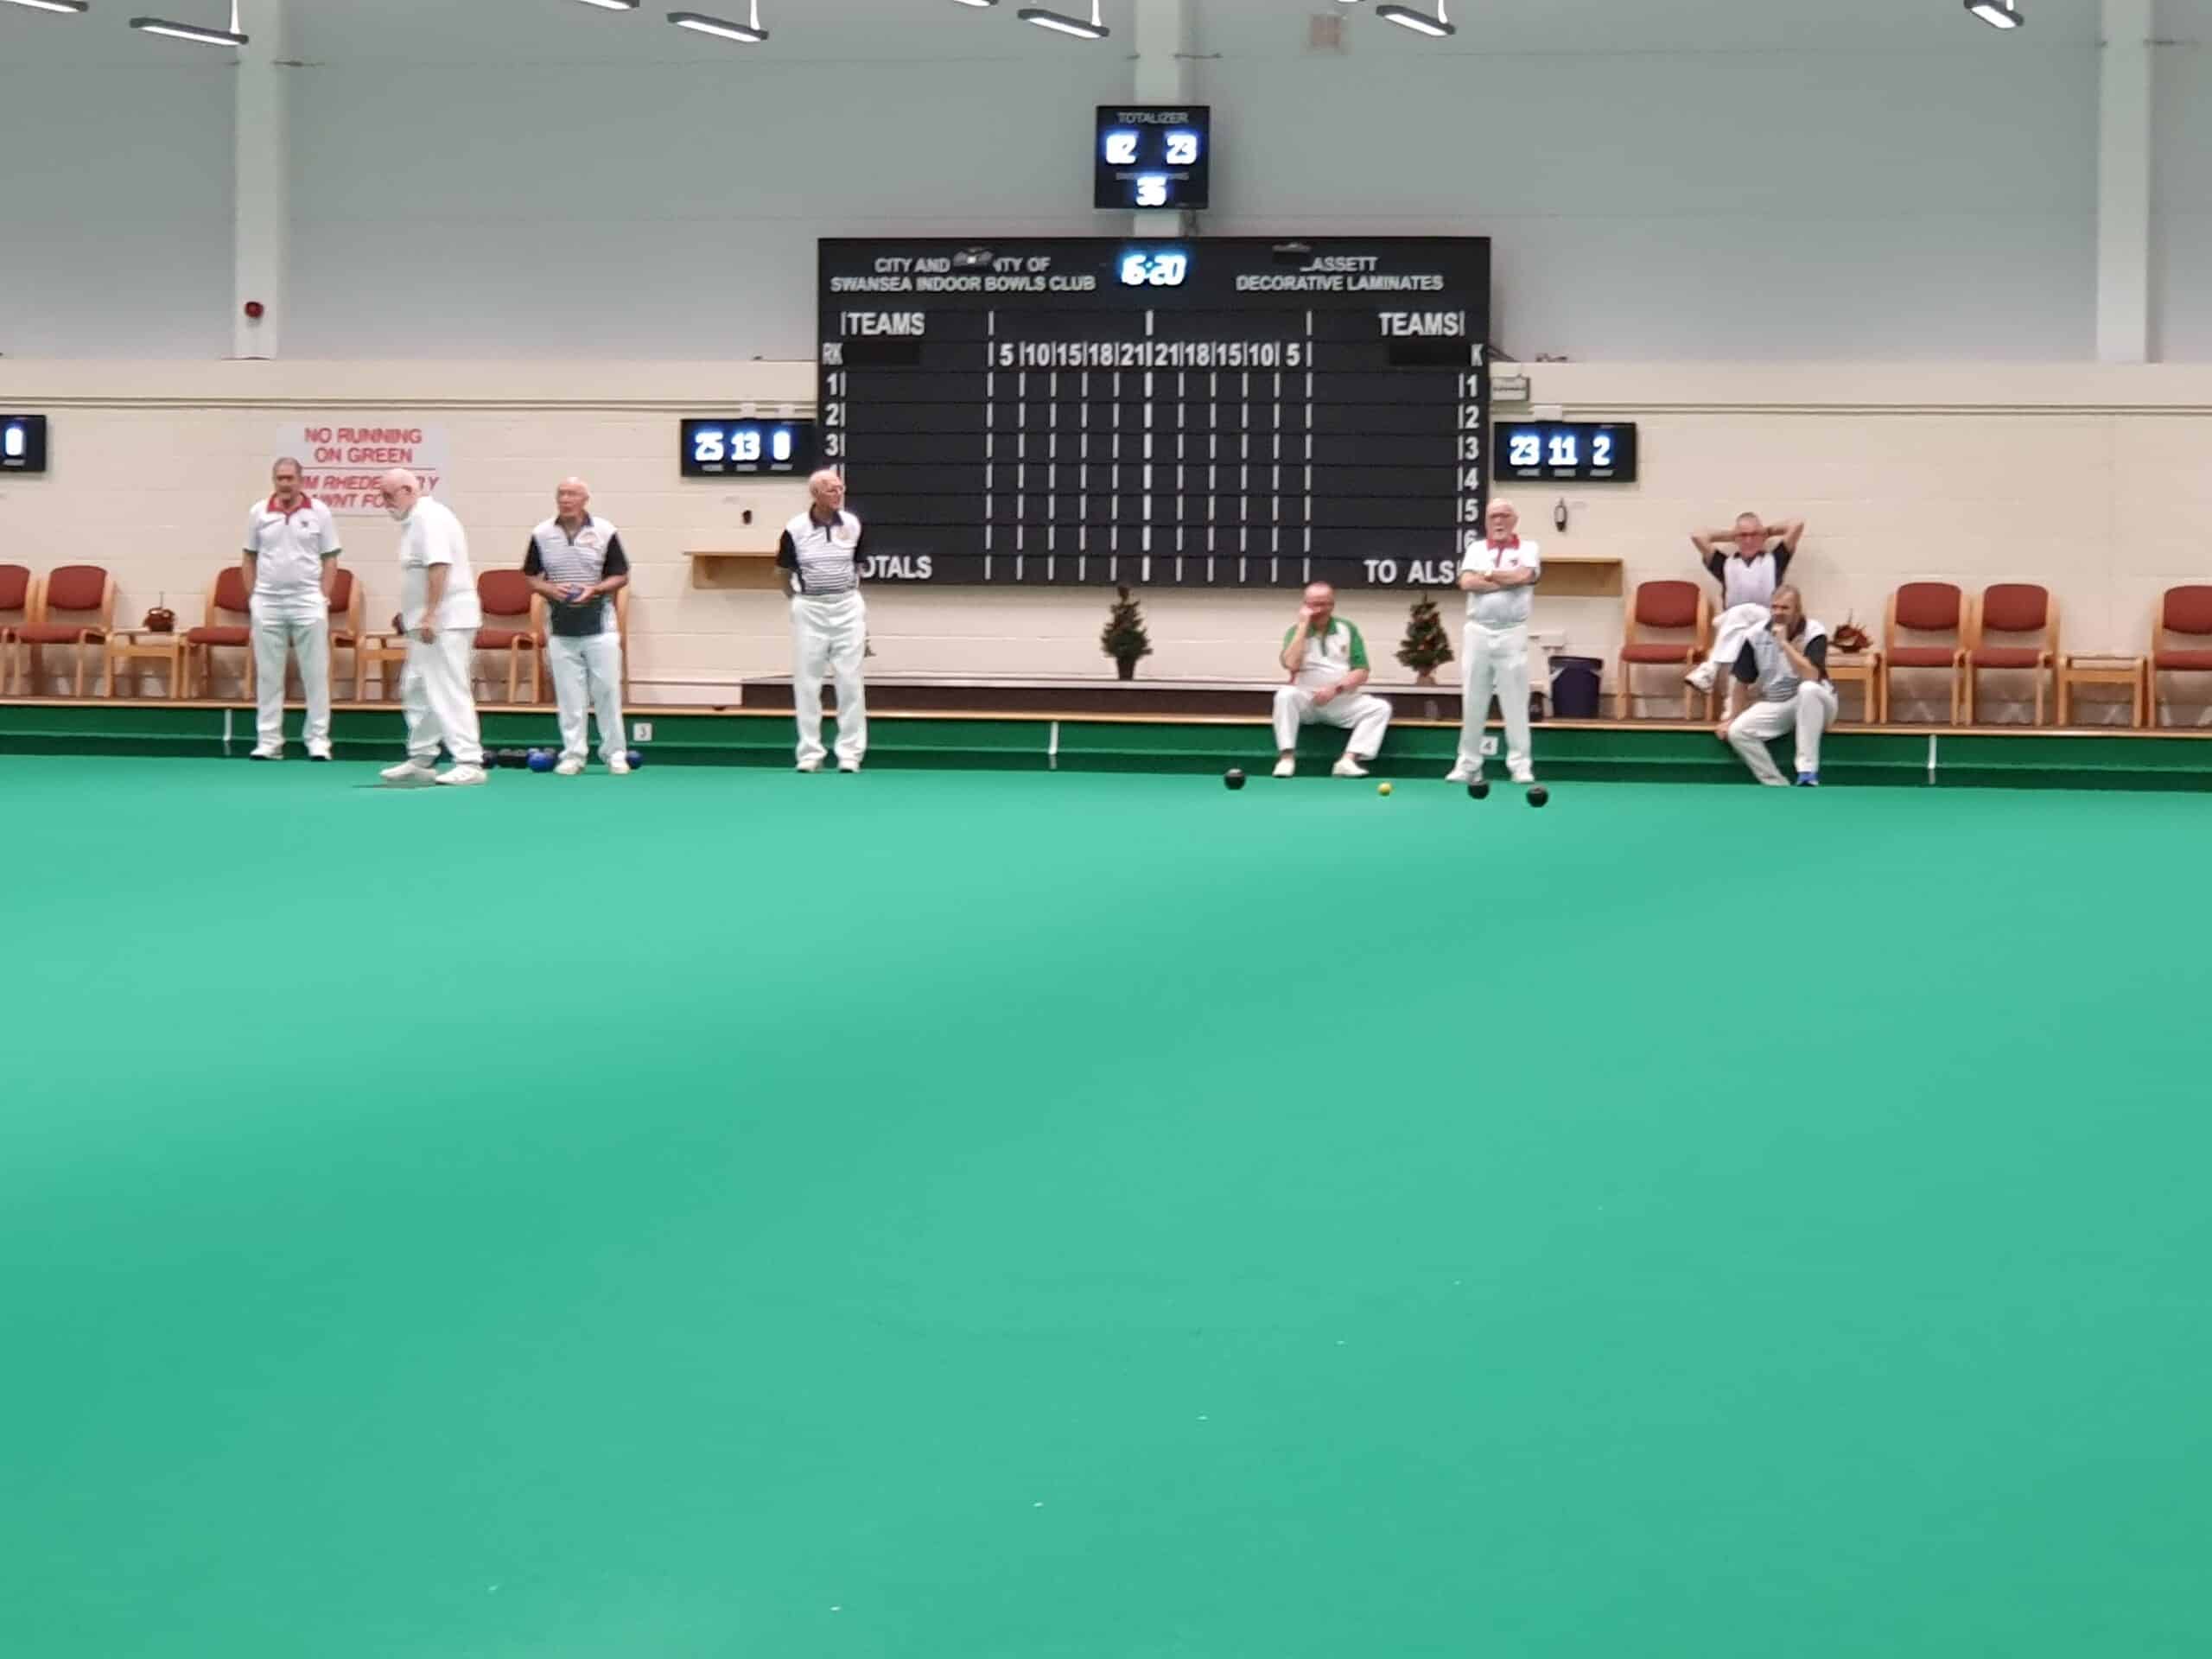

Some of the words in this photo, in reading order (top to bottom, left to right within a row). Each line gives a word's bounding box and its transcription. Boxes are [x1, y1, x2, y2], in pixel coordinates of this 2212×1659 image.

[874, 257, 912, 272] CITY
[913, 257, 950, 272] AND
[1027, 257, 1051, 271] OF
[830, 276, 912, 292] SWANSEA
[916, 276, 981, 291] INDOOR
[985, 276, 1046, 291] BOWLS
[1049, 276, 1096, 291] CLUB
[1236, 275, 1343, 291] DECORATIVE
[1346, 275, 1444, 291] LAMINATES
[849, 312, 925, 335] TEAMS
[1379, 312, 1459, 336] TEAMS
[1000, 344, 1014, 365] 5
[1026, 344, 1050, 365] 10
[1056, 344, 1082, 365] 15
[1088, 344, 1114, 365] 18
[1120, 344, 1145, 365] 21
[1154, 344, 1179, 366] 21
[1185, 344, 1211, 366] 18
[1217, 344, 1242, 366] 15
[1249, 344, 1274, 366] 10
[1286, 344, 1300, 366] 5
[826, 373, 838, 396] 1
[1466, 374, 1478, 397] 1
[824, 404, 839, 426] 2
[1465, 405, 1479, 429] 2
[305, 428, 332, 443] NO
[337, 428, 422, 443] RUNNING
[731, 431, 760, 461] 13
[824, 434, 838, 456] 3
[314, 448, 341, 463] ON
[347, 448, 413, 463] GREEN
[1465, 436, 1479, 461] 3
[1510, 435, 1541, 466] 23
[1548, 435, 1578, 466] 11
[1592, 435, 1611, 467] 2
[1464, 467, 1479, 491] 4
[1465, 499, 1478, 522] 5
[860, 556, 932, 579] OTALS
